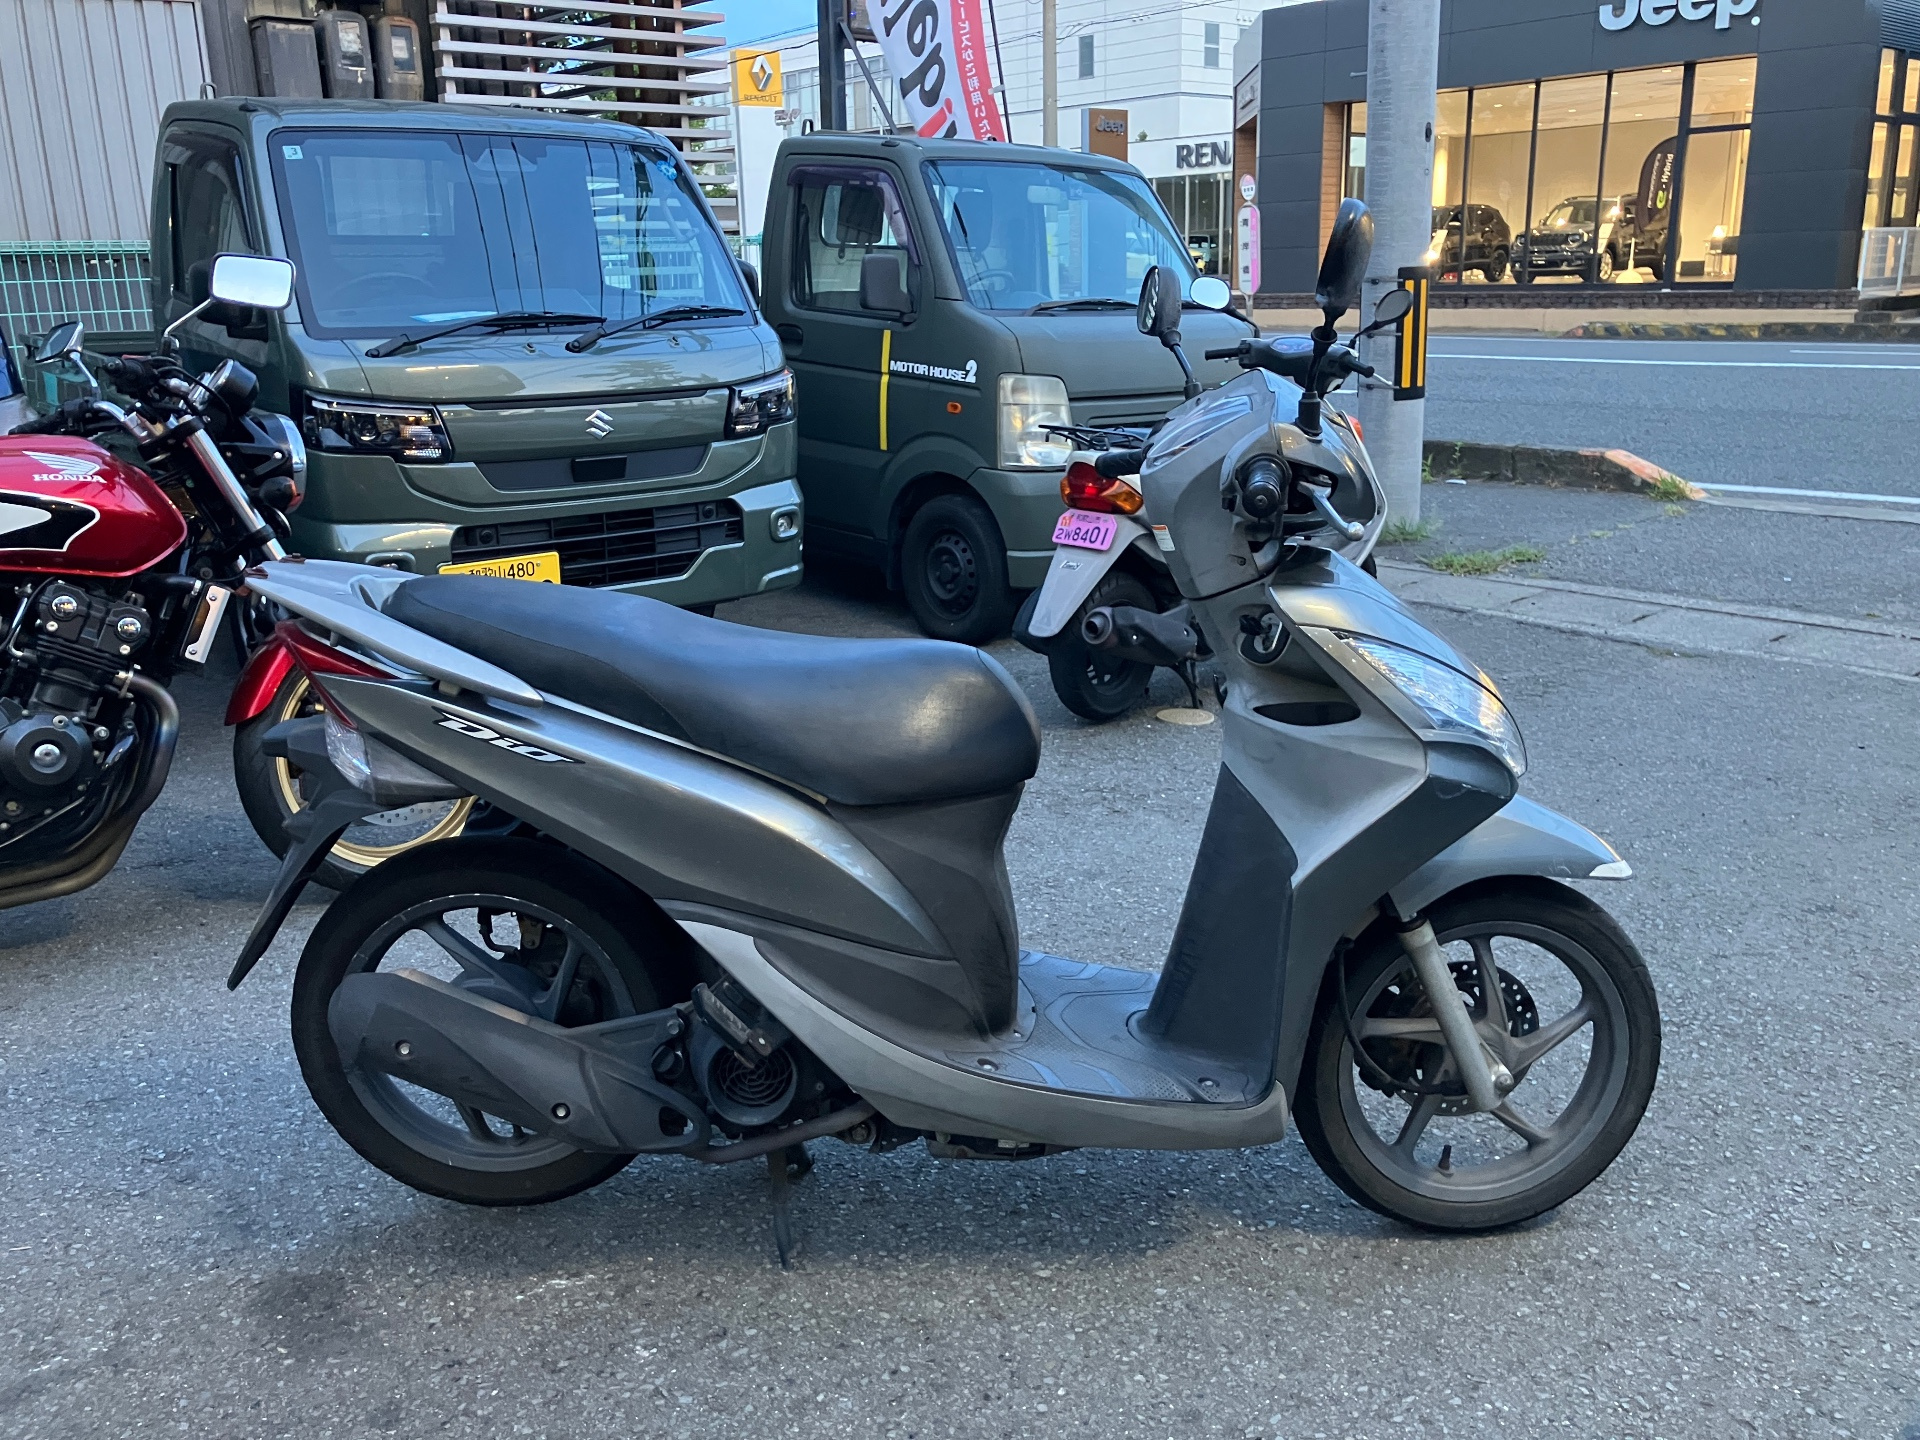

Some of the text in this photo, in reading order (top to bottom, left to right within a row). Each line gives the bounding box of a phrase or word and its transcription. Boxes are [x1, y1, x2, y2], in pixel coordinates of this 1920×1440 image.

[1176, 141, 1232, 168] REN
[890, 360, 928, 376] MOTOR
[32, 473, 107, 484] HONDA
[438, 711, 575, 762] Dio
